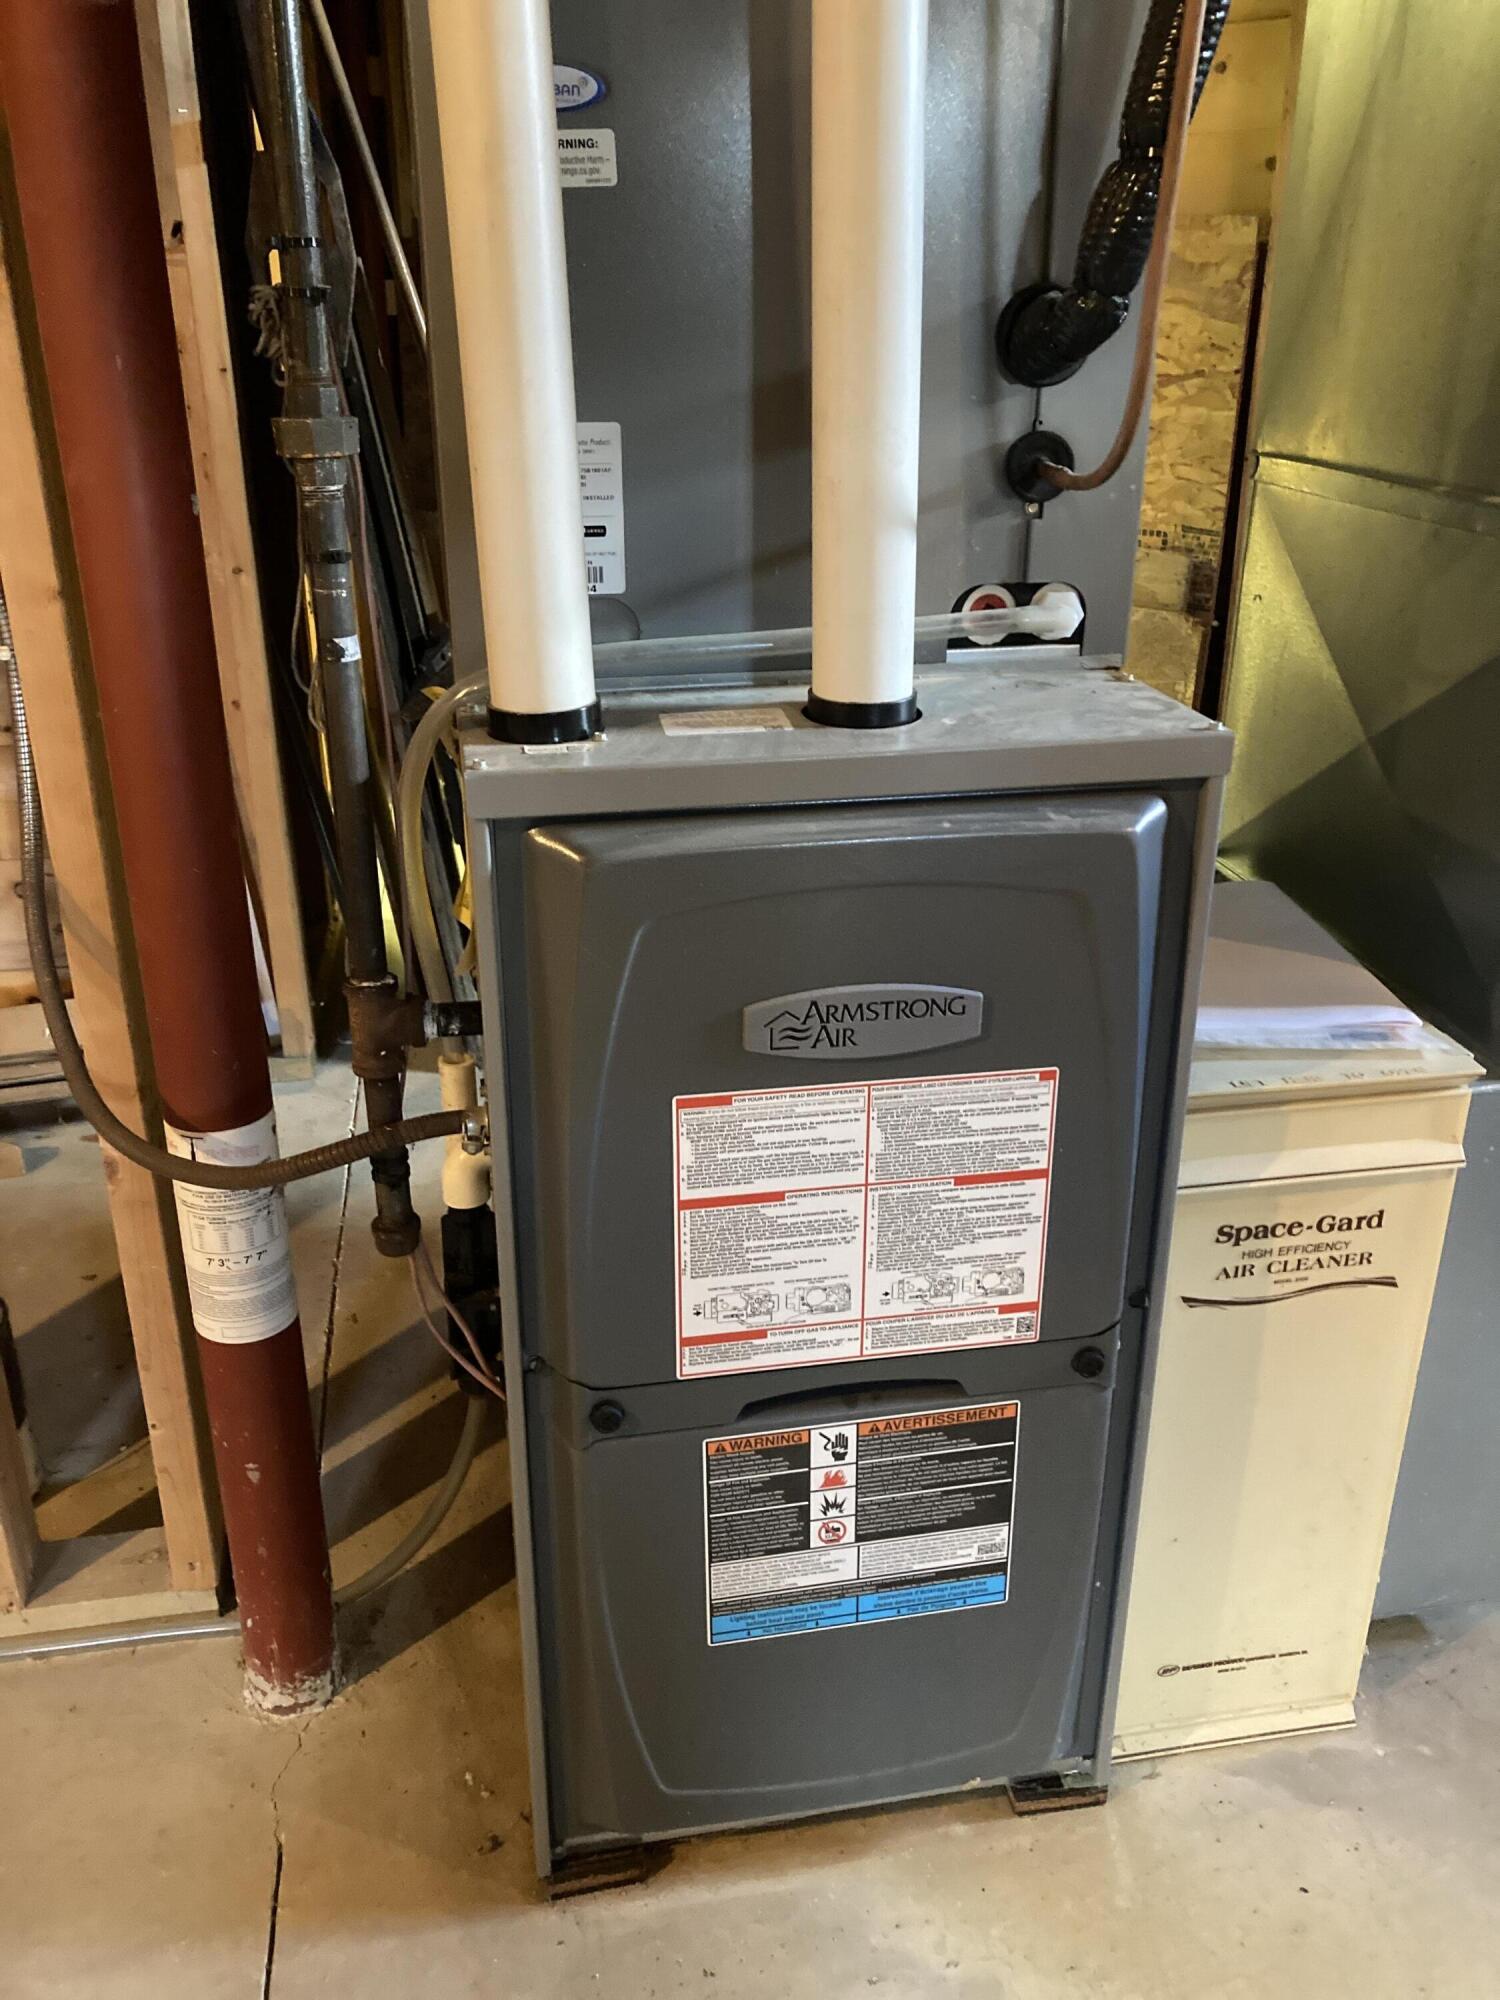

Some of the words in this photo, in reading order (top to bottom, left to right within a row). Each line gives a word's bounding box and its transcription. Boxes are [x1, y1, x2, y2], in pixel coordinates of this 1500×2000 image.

[553, 84, 580, 97] BAN
[558, 138, 599, 149] RNING:
[1215, 1209, 1385, 1247] Space-Gard
[1241, 1248, 1273, 1260] HIGH
[1278, 1240, 1352, 1257] EFFICIENCY
[1215, 1263, 1256, 1281] AIR
[1267, 1251, 1373, 1275] CLEANER
[884, 1407, 1007, 1432] AVERTISSEMENT
[729, 1433, 802, 1451] WARNING
